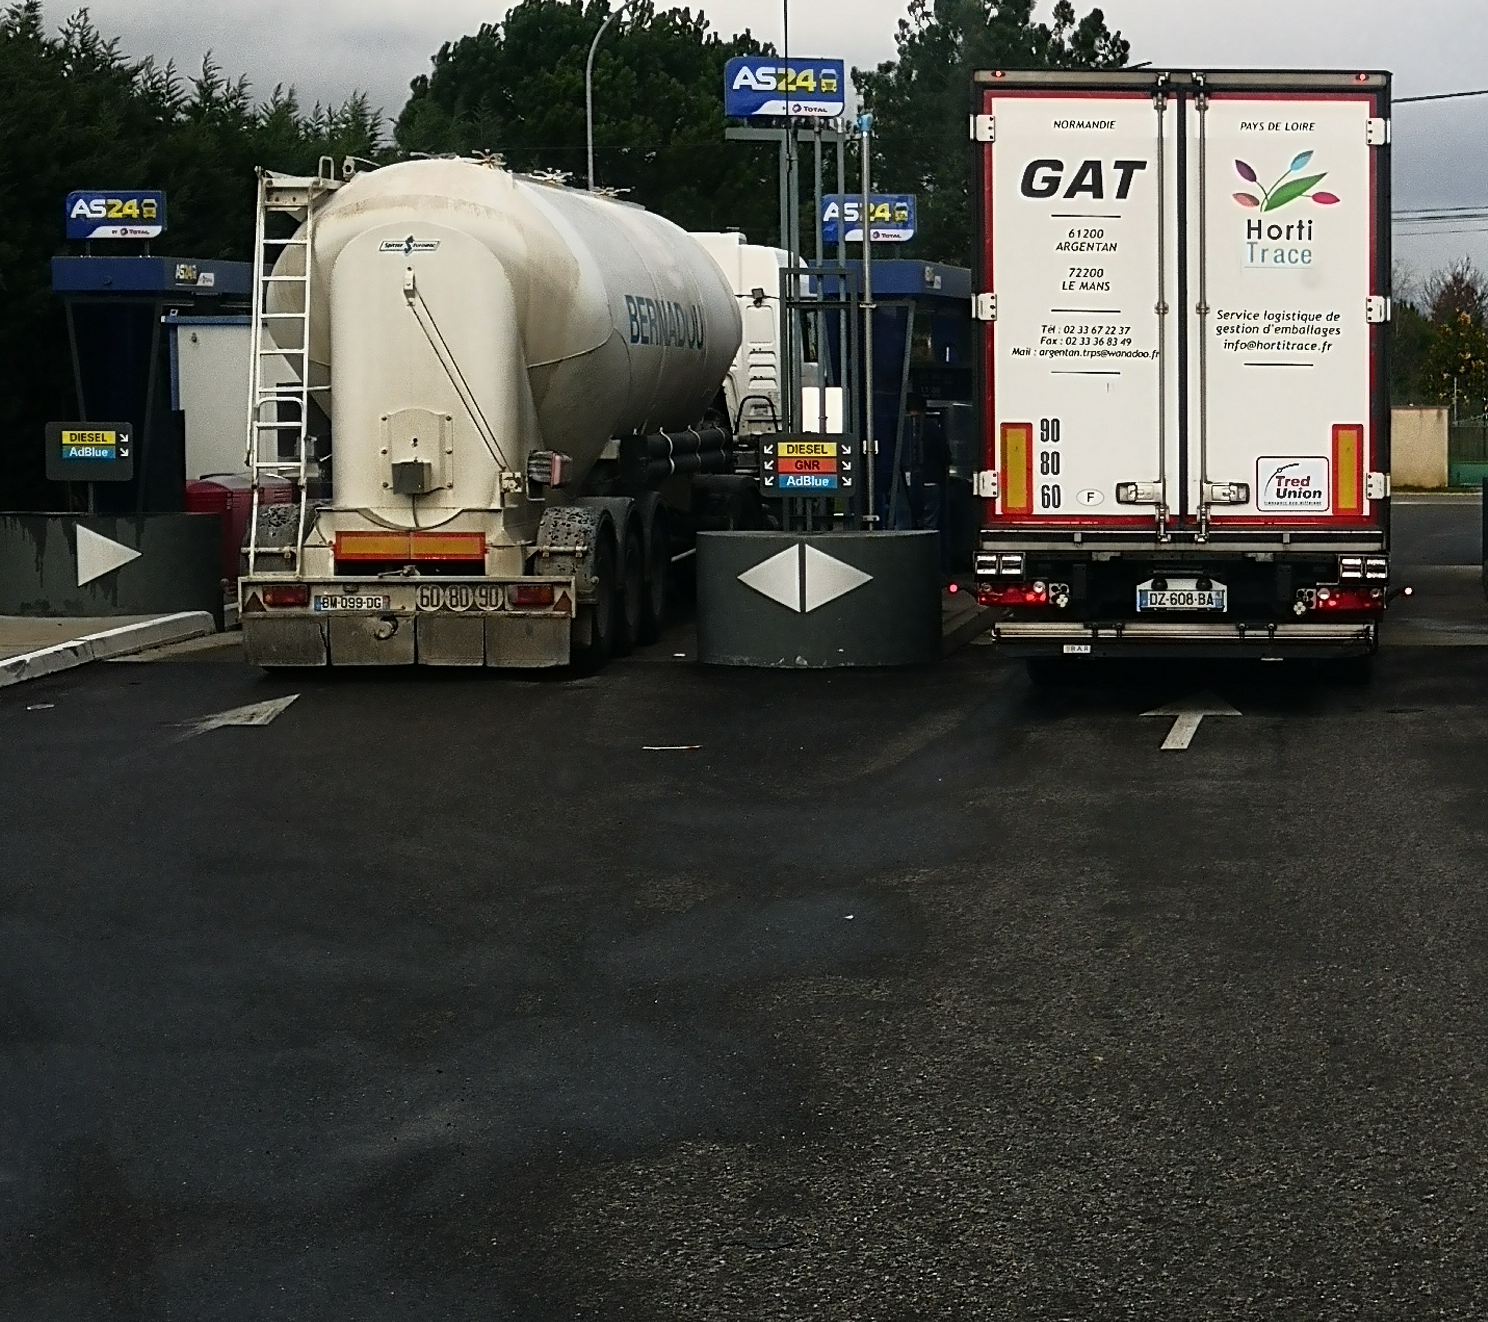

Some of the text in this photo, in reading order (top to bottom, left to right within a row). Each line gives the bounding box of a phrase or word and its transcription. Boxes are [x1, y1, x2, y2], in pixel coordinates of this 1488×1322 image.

[732, 65, 817, 92] AS24
[803, 105, 828, 113] TOTAL
[1053, 120, 1117, 129] NORMANDIE
[1239, 121, 1316, 132] PAYS DE LOIRE
[1020, 159, 1148, 199] GAT
[70, 198, 140, 219] AS24
[1068, 228, 1104, 239] 61200
[1246, 219, 1313, 241] Horti
[1055, 242, 1118, 252] ARGENTAN
[1246, 241, 1312, 265] Trace
[1068, 267, 1104, 278] 72200
[1061, 281, 1111, 292] LE MANS
[1216, 309, 1341, 323] Service logistique de
[1041, 324, 1056, 334] Tél
[1063, 325, 1076, 334] 02
[1077, 325, 1089, 334] 33
[1091, 325, 1104, 334] 67
[1105, 325, 1116, 335] 22
[1118, 326, 1131, 335] 37
[1215, 323, 1342, 337] gestion d'emballages
[1040, 336, 1058, 345] Fax
[1065, 336, 1078, 346] 02
[1079, 337, 1091, 346] 33
[1093, 337, 1105, 346] 36
[1106, 337, 1118, 346] 83
[1120, 337, 1132, 346] 49
[1223, 339, 1333, 353] info@hortitrace.fr
[1011, 347, 1031, 356] Mail
[1039, 348, 1160, 360] argentan.trps@wanadoo.fr
[1040, 418, 1060, 443] 90
[69, 432, 108, 442] DIESEL
[69, 446, 108, 457] AdBlue
[786, 444, 828, 454] DIESEL
[794, 460, 820, 471] GNR
[1040, 451, 1060, 475] 80
[786, 475, 829, 487] AdBlue
[1275, 475, 1311, 487] Tred
[1041, 484, 1061, 508] 60
[1086, 491, 1095, 503] F
[1275, 487, 1323, 500] Union
[321, 596, 382, 609] BM-099-DG
[419, 586, 499, 608] 60 80 90
[1149, 592, 1214, 606] DZ-608-BA
